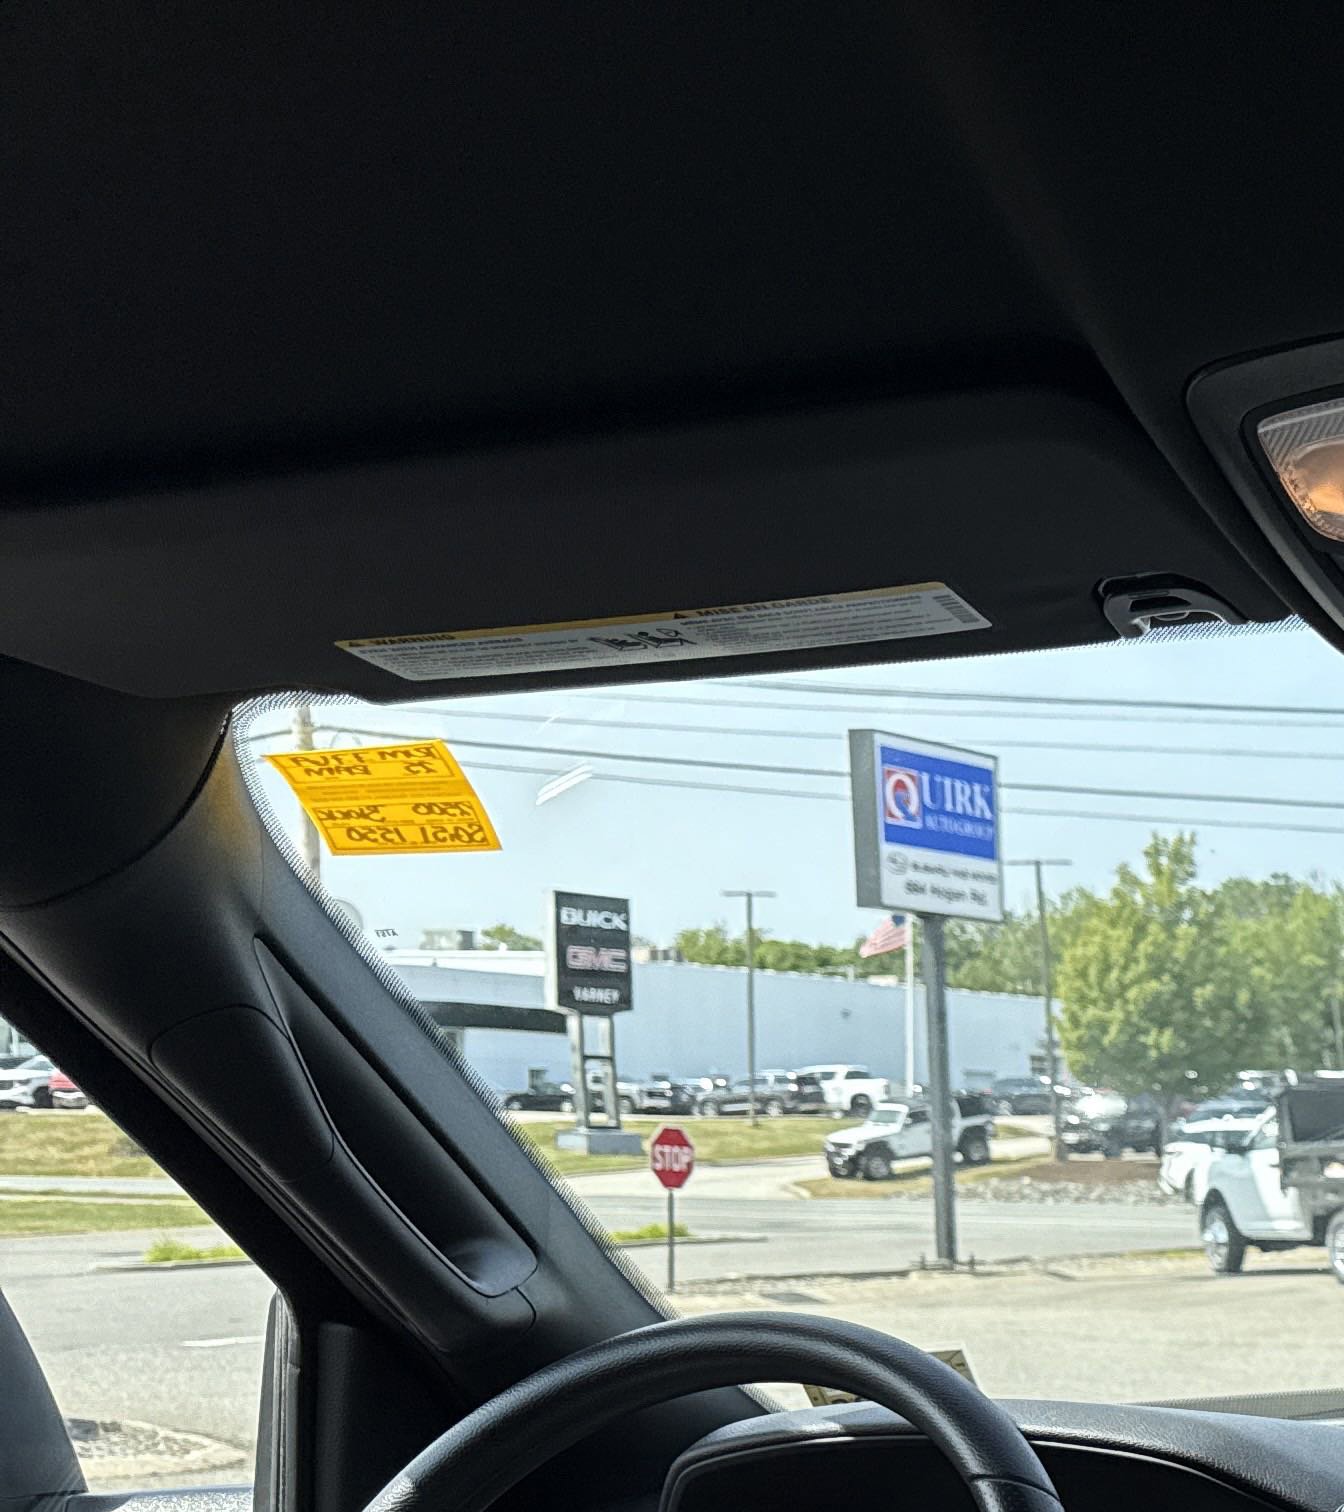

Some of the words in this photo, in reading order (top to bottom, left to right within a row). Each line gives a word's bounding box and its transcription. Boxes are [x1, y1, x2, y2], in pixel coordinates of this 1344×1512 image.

[560, 906, 628, 931] BUICK
[566, 945, 628, 973] GMC
[653, 1143, 693, 1172] STOP
